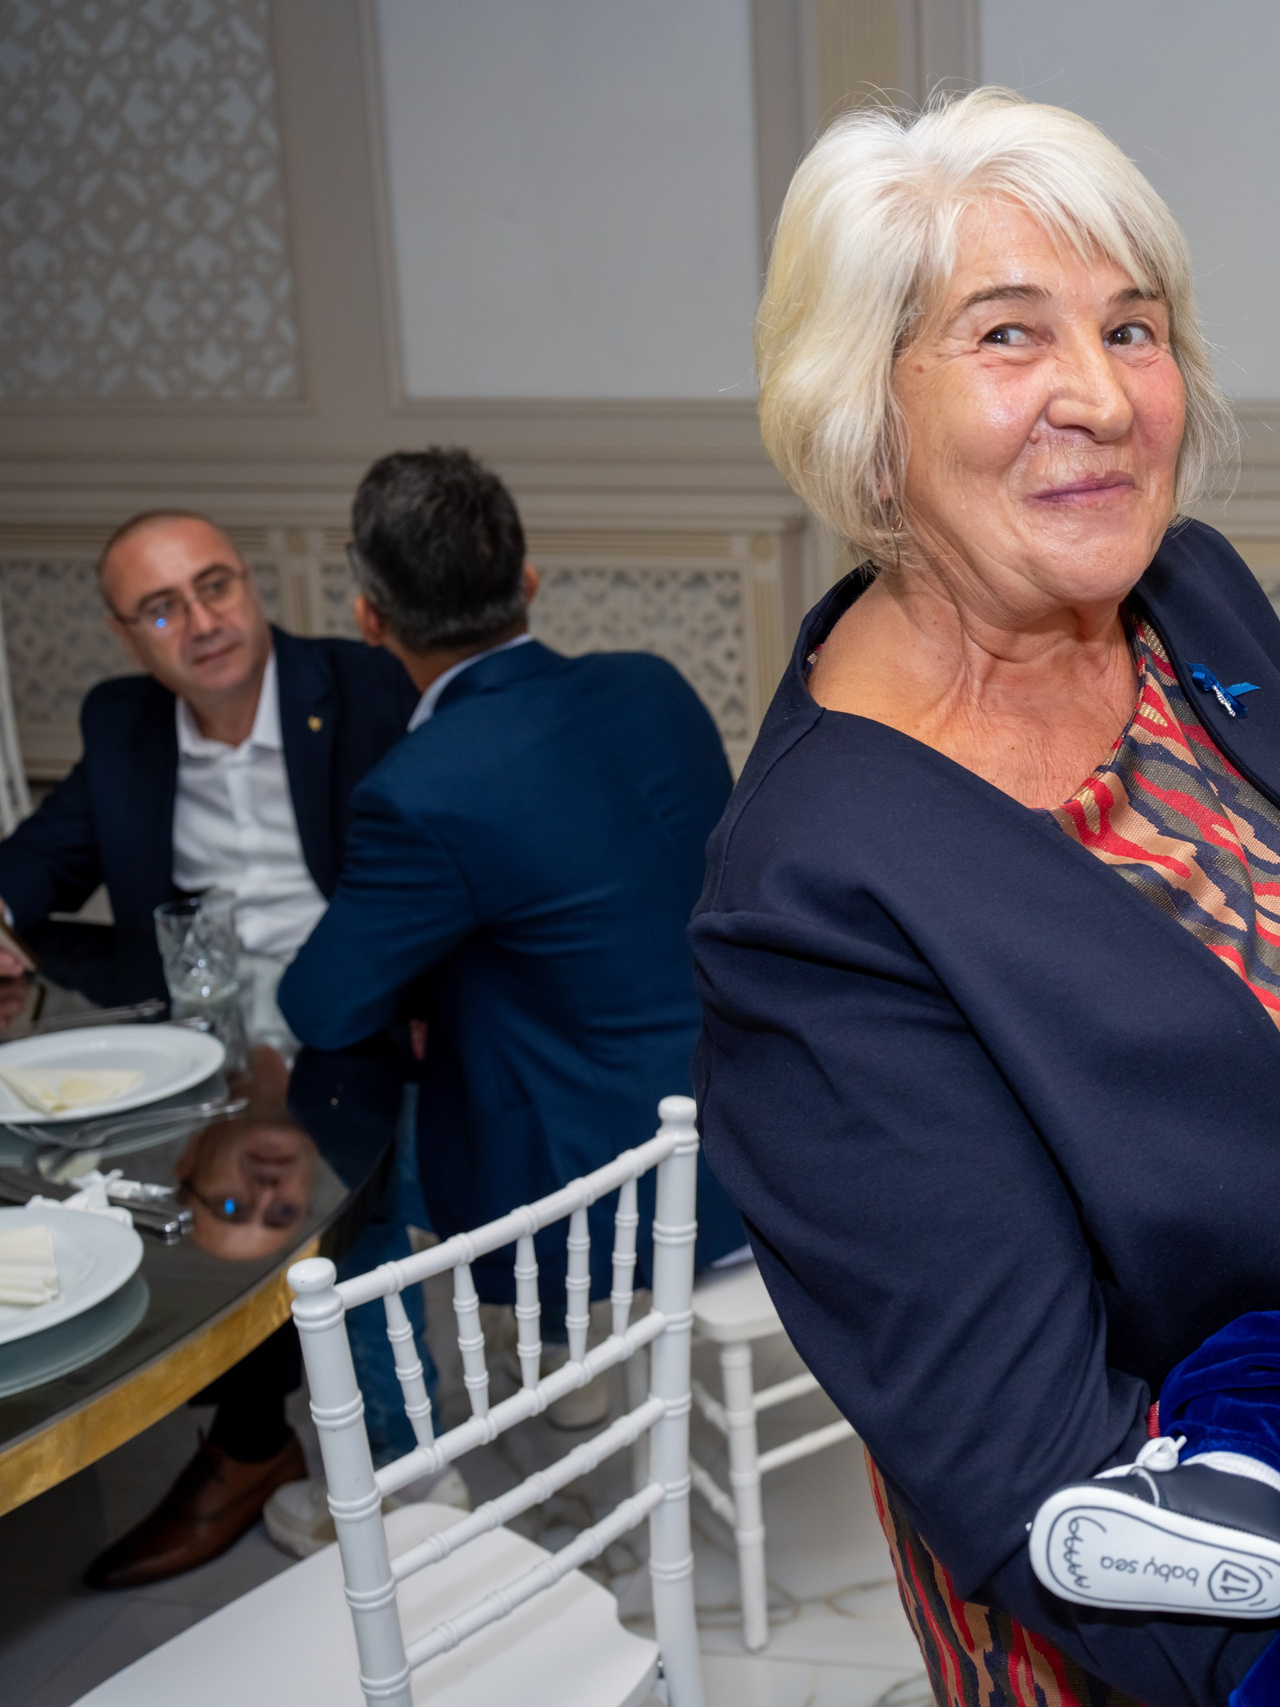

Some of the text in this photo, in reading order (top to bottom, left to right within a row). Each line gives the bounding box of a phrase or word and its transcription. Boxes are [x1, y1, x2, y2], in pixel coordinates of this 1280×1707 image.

[1100, 1556, 1200, 1587] baby sea
[1219, 1569, 1250, 1595] 17
